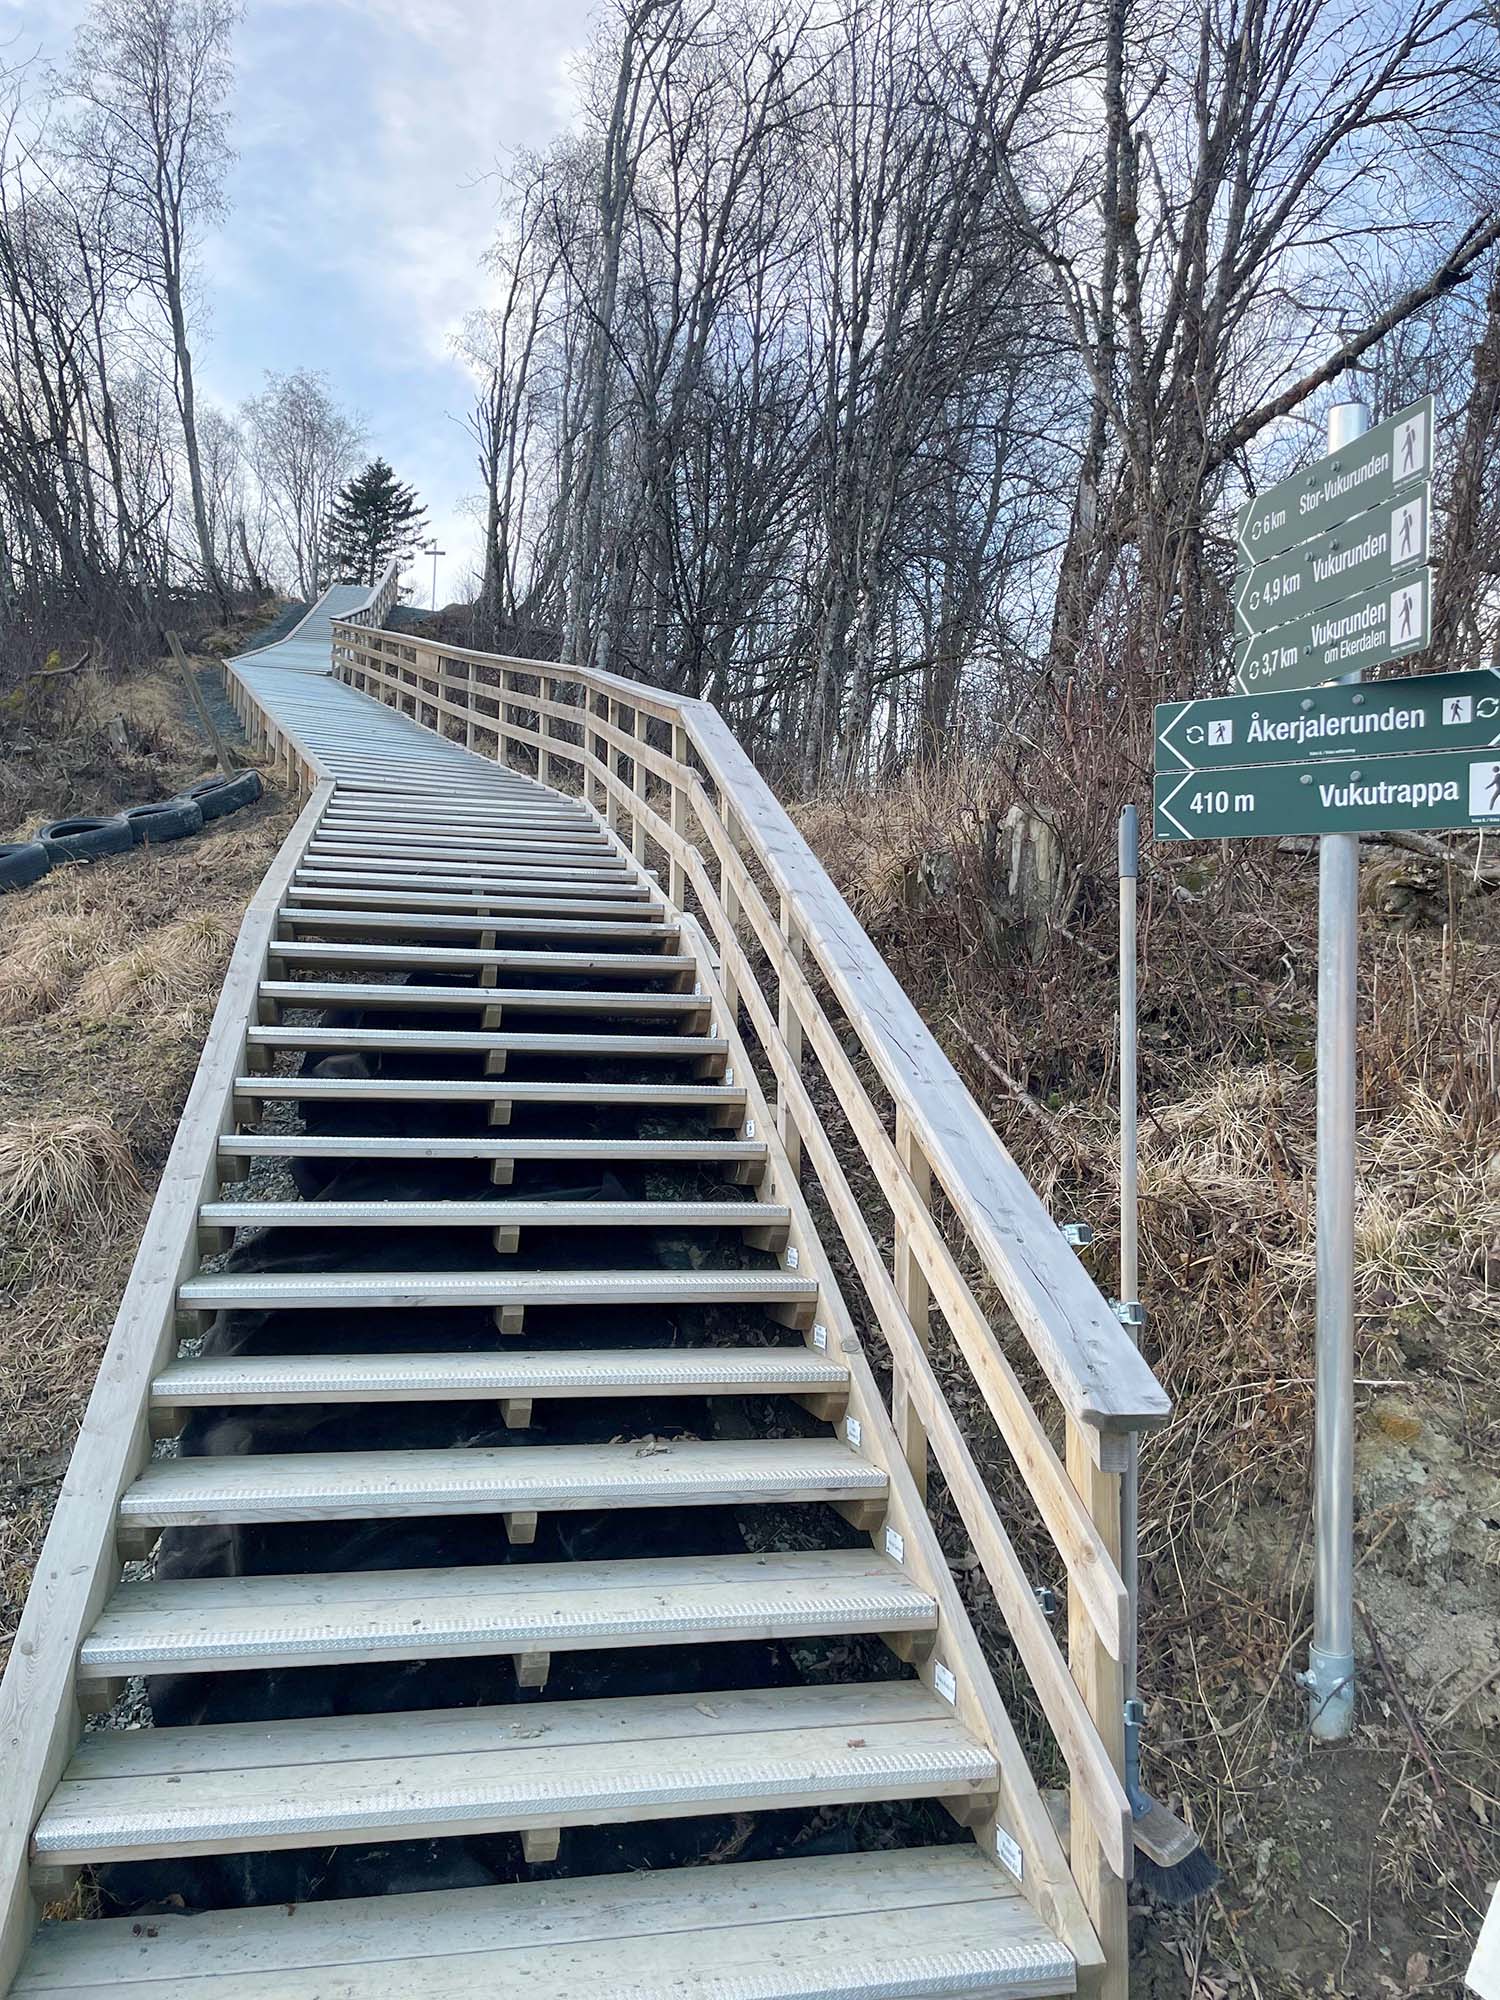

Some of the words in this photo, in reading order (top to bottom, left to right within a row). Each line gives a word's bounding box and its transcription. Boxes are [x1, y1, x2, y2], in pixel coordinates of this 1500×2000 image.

[1263, 514, 1270, 535] 6
[1271, 509, 1286, 531] km
[1299, 452, 1389, 516] Stor-Vukurunden
[1263, 577, 1280, 607] 4,9
[1282, 573, 1300, 597] km
[1312, 532, 1387, 583] Vukurunden
[1311, 602, 1386, 648] Vukurunden
[1262, 649, 1279, 677] 3,7
[1280, 646, 1297, 669] km
[1324, 646, 1339, 665] om
[1340, 629, 1386, 660] Ekerdalen
[1246, 706, 1425, 745] Åkerjalerunden
[1189, 790, 1229, 814] 410
[1234, 792, 1255, 813] m
[1318, 781, 1460, 808] Vukutrappa
